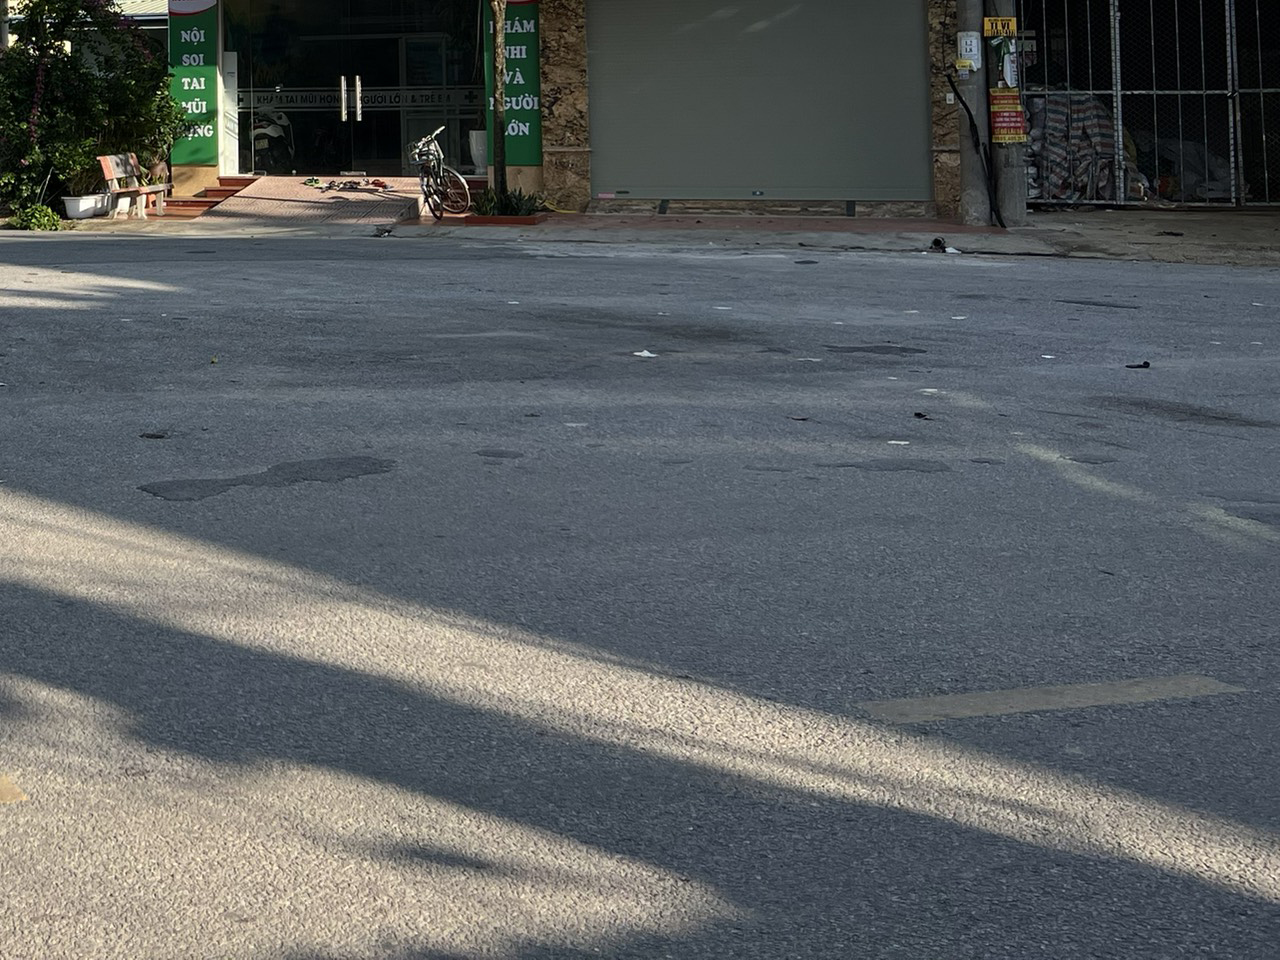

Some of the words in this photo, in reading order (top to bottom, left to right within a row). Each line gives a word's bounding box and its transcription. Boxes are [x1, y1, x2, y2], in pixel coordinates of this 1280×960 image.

[181, 27, 206, 46] NỘI
[182, 53, 205, 66] SOI
[182, 77, 206, 90] TAI
[286, 95, 298, 104] TAI
[300, 93, 317, 104] MŨI
[505, 119, 530, 136] ỚN
